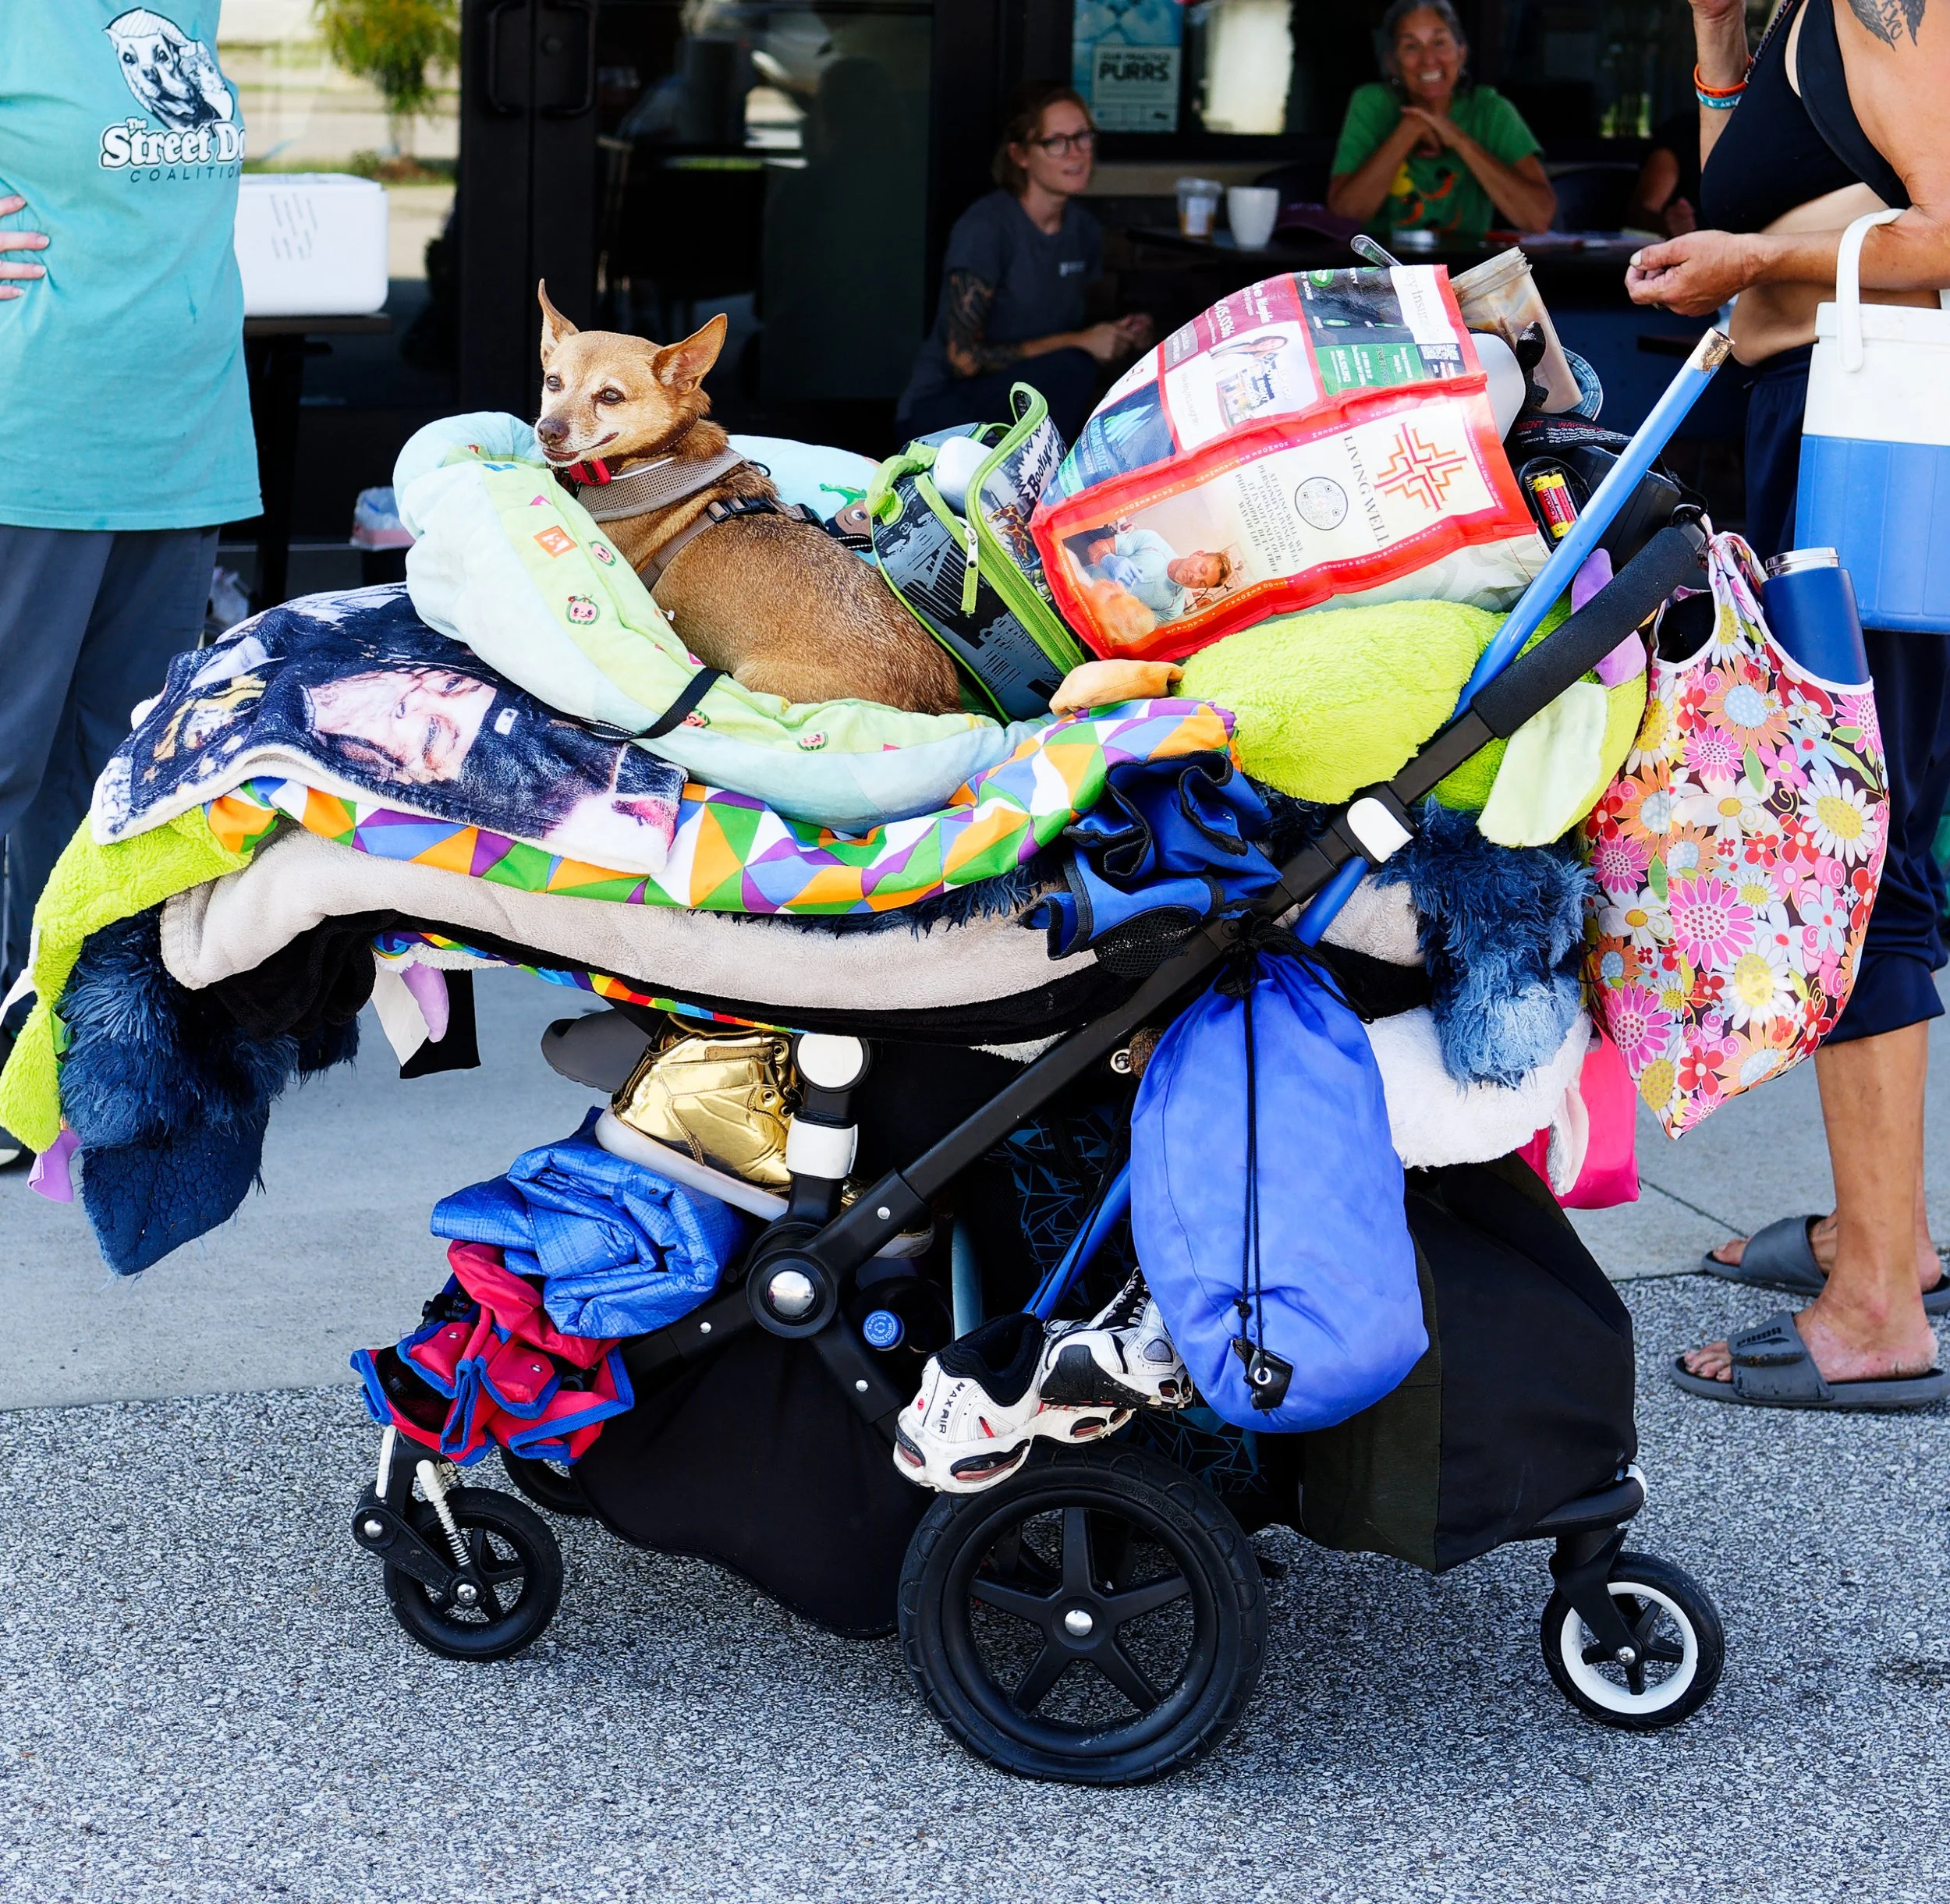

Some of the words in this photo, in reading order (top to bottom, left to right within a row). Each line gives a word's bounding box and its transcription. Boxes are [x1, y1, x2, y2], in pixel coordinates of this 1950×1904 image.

[1099, 62, 1169, 81] PURRS
[127, 118, 147, 130] The
[101, 126, 211, 168] Street
[1093, 445, 1110, 471] STATE
[1251, 441, 1289, 456] HORMONE
[1342, 435, 1372, 495] LIVING
[1362, 498, 1391, 548] WELL
[1115, 497, 1150, 514] REMOVAL
[944, 1382, 966, 1408] MAX
[939, 1409, 949, 1434] AIR
